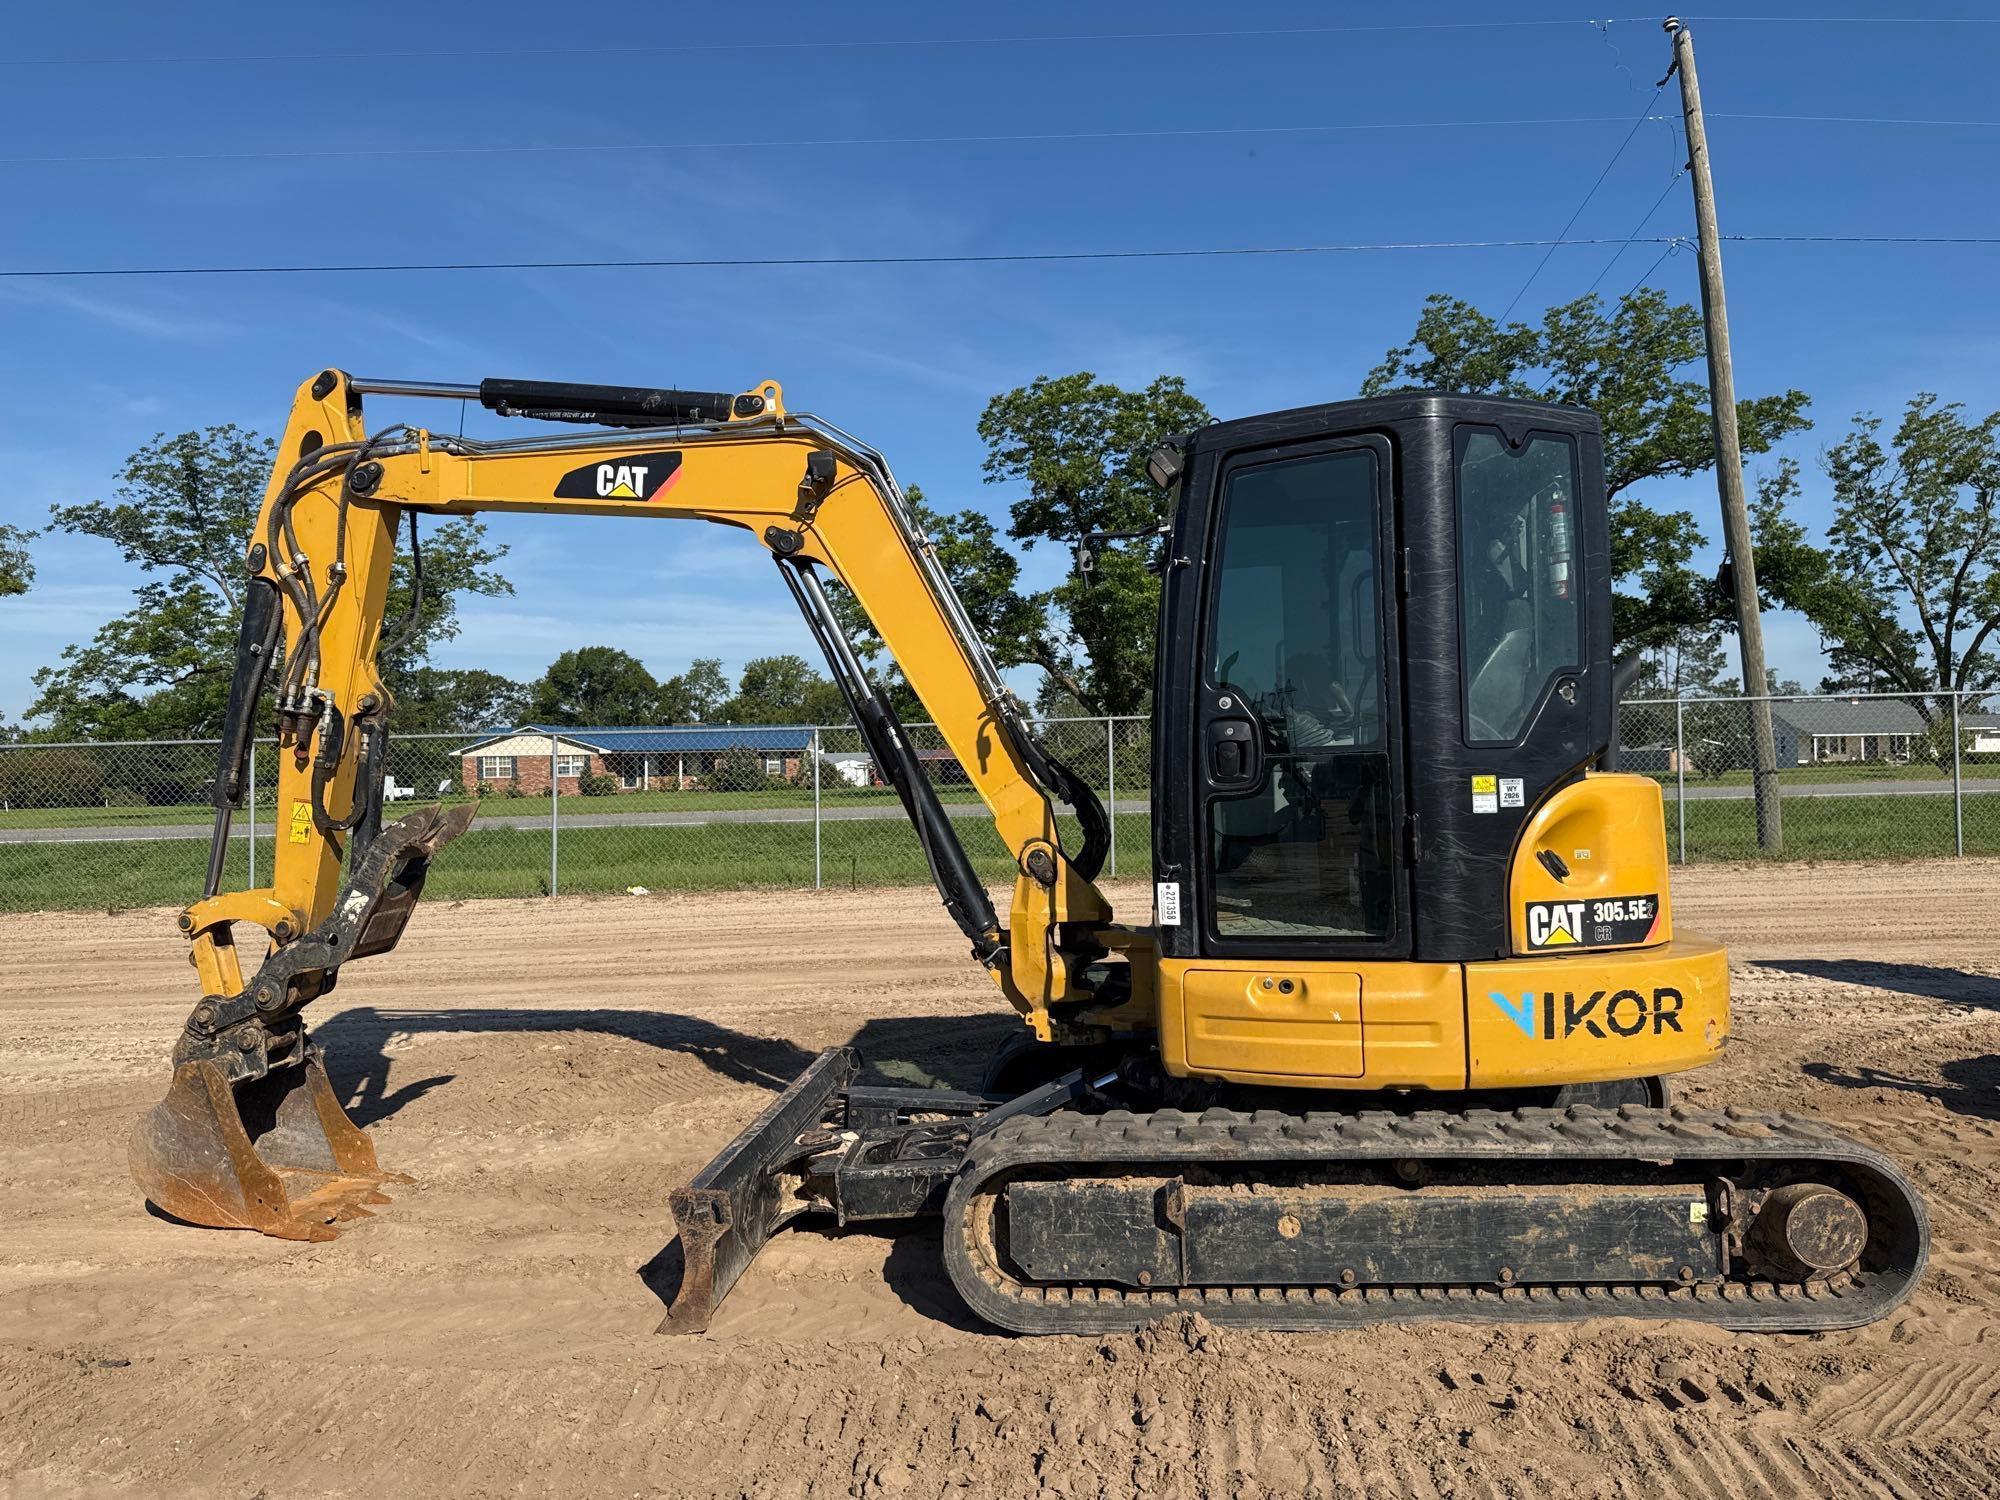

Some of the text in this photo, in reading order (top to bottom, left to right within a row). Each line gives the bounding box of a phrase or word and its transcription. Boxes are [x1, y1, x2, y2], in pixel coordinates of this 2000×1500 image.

[596, 464, 648, 498] CAT
[1166, 891, 1176, 920] 221358
[1529, 904, 1586, 946] CAT
[1594, 925, 1612, 941] CR
[1487, 987, 1684, 1040] VIKOR
